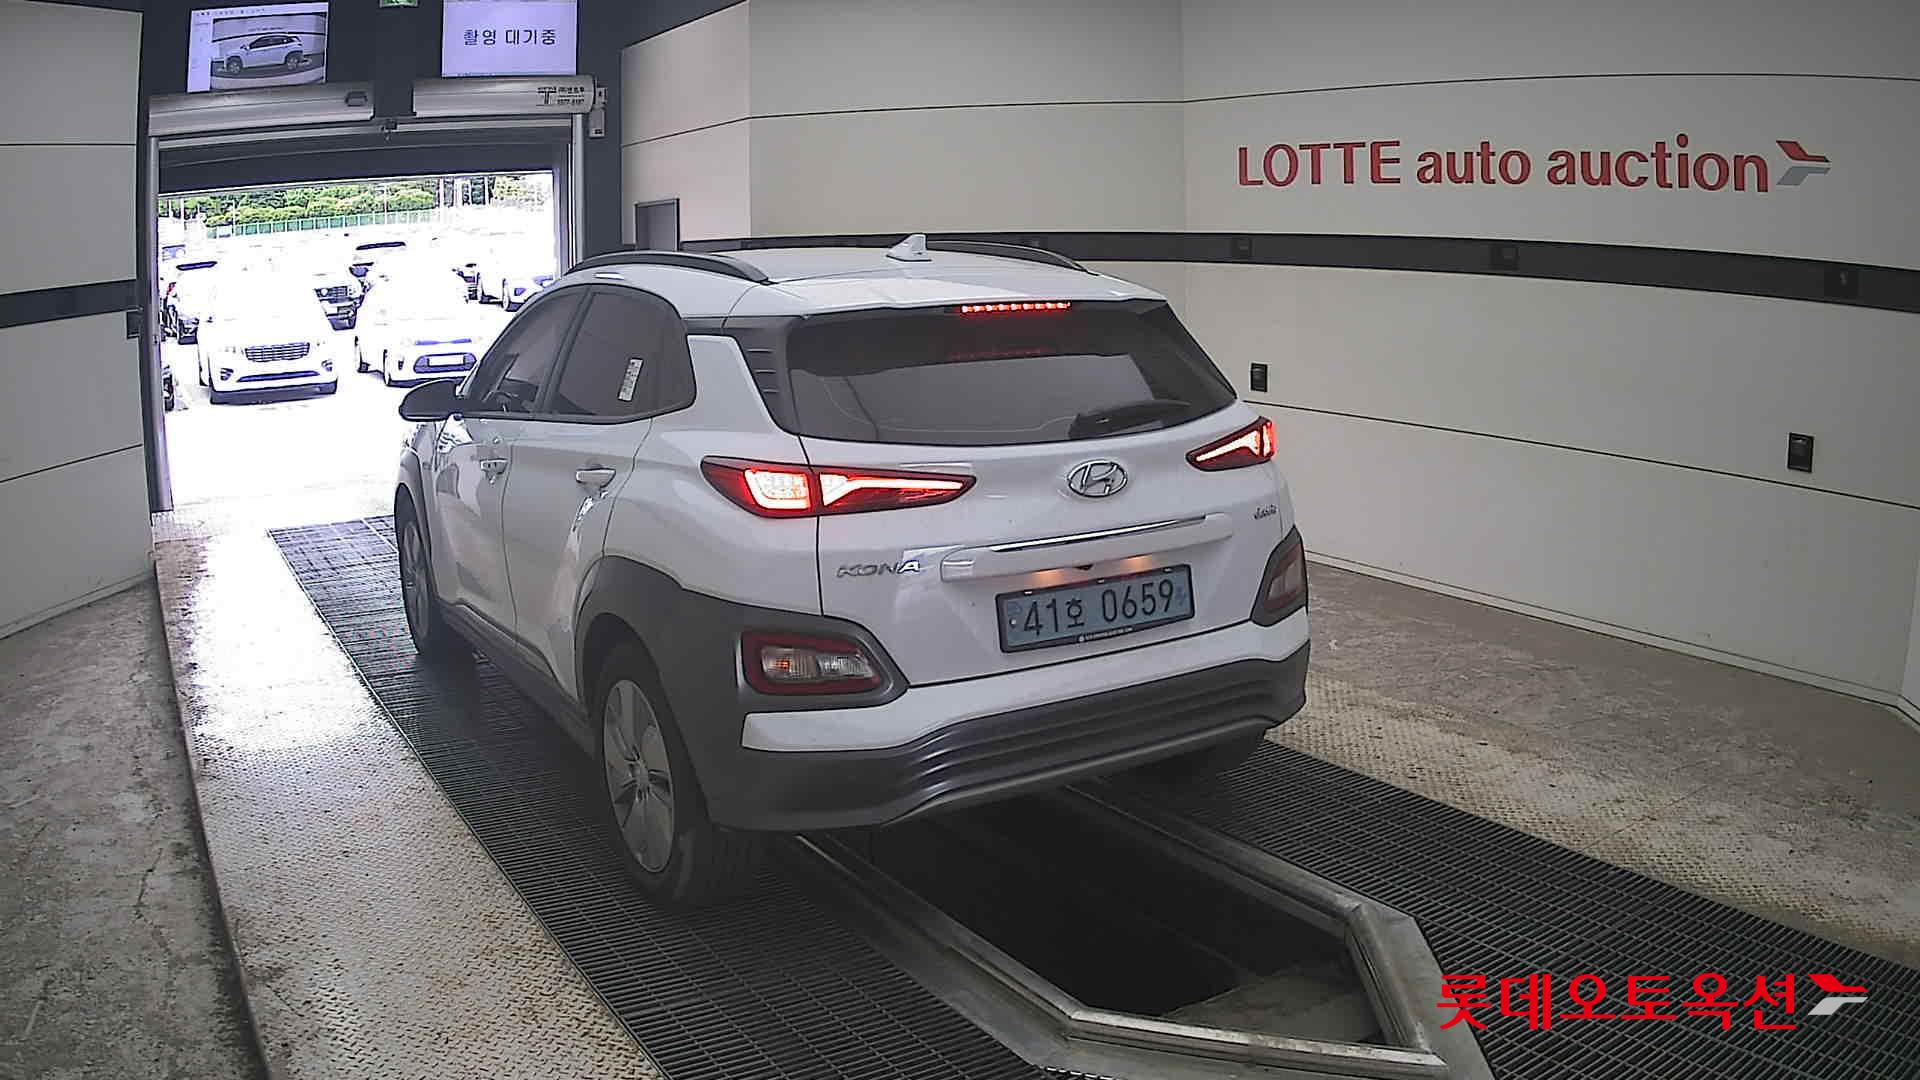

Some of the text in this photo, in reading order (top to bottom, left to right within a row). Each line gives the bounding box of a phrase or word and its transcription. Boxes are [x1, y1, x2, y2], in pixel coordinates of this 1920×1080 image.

[464, 29, 556, 46] 촬영 대기중
[1238, 133, 1769, 192] LOTTE auto auction
[836, 559, 921, 578] KONA
[1023, 579, 1174, 637] 41호 0659
